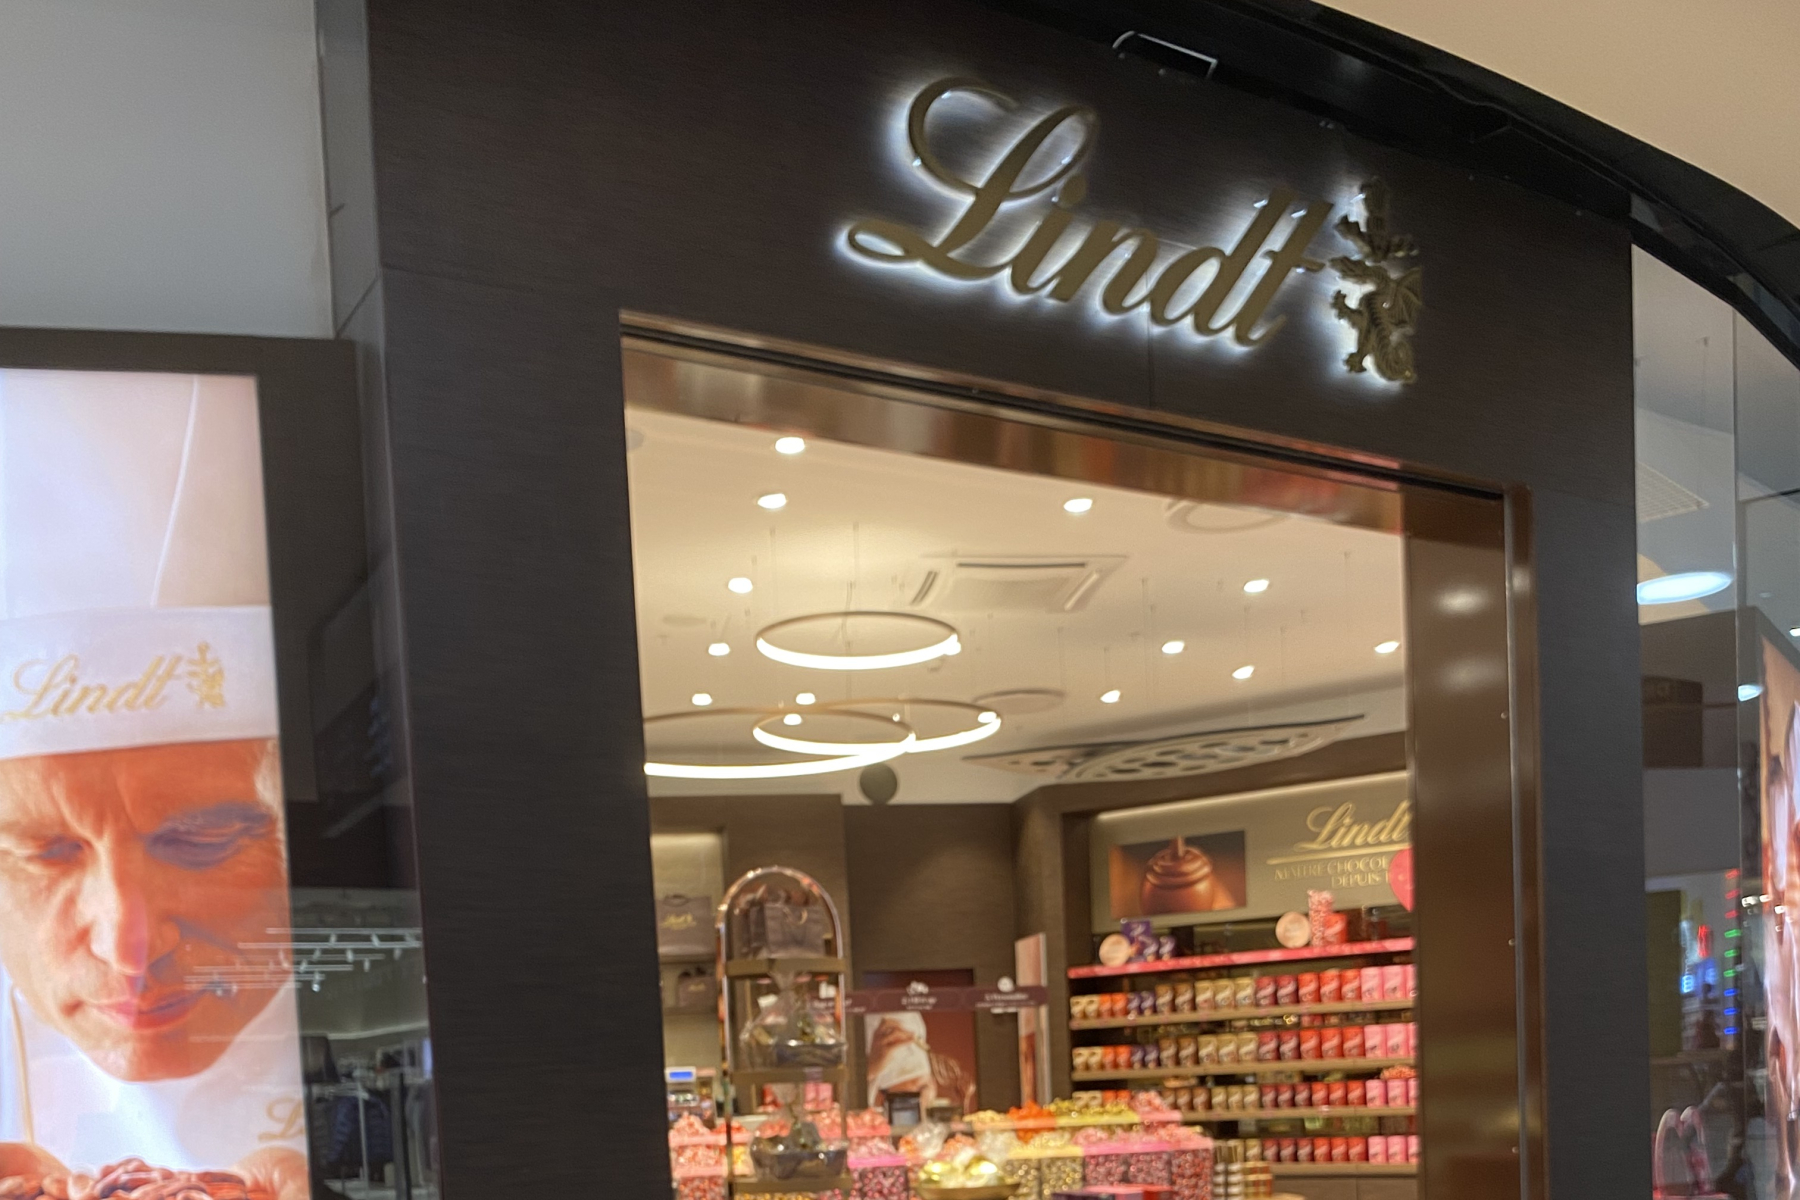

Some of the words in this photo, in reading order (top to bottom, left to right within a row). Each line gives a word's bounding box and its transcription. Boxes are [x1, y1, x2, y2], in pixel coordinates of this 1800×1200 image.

[847, 76, 1334, 347] Lindt
[1, 653, 182, 720] Lindt
[1327, 855, 1389, 875] CHOCOL
[256, 1096, 305, 1143] L
